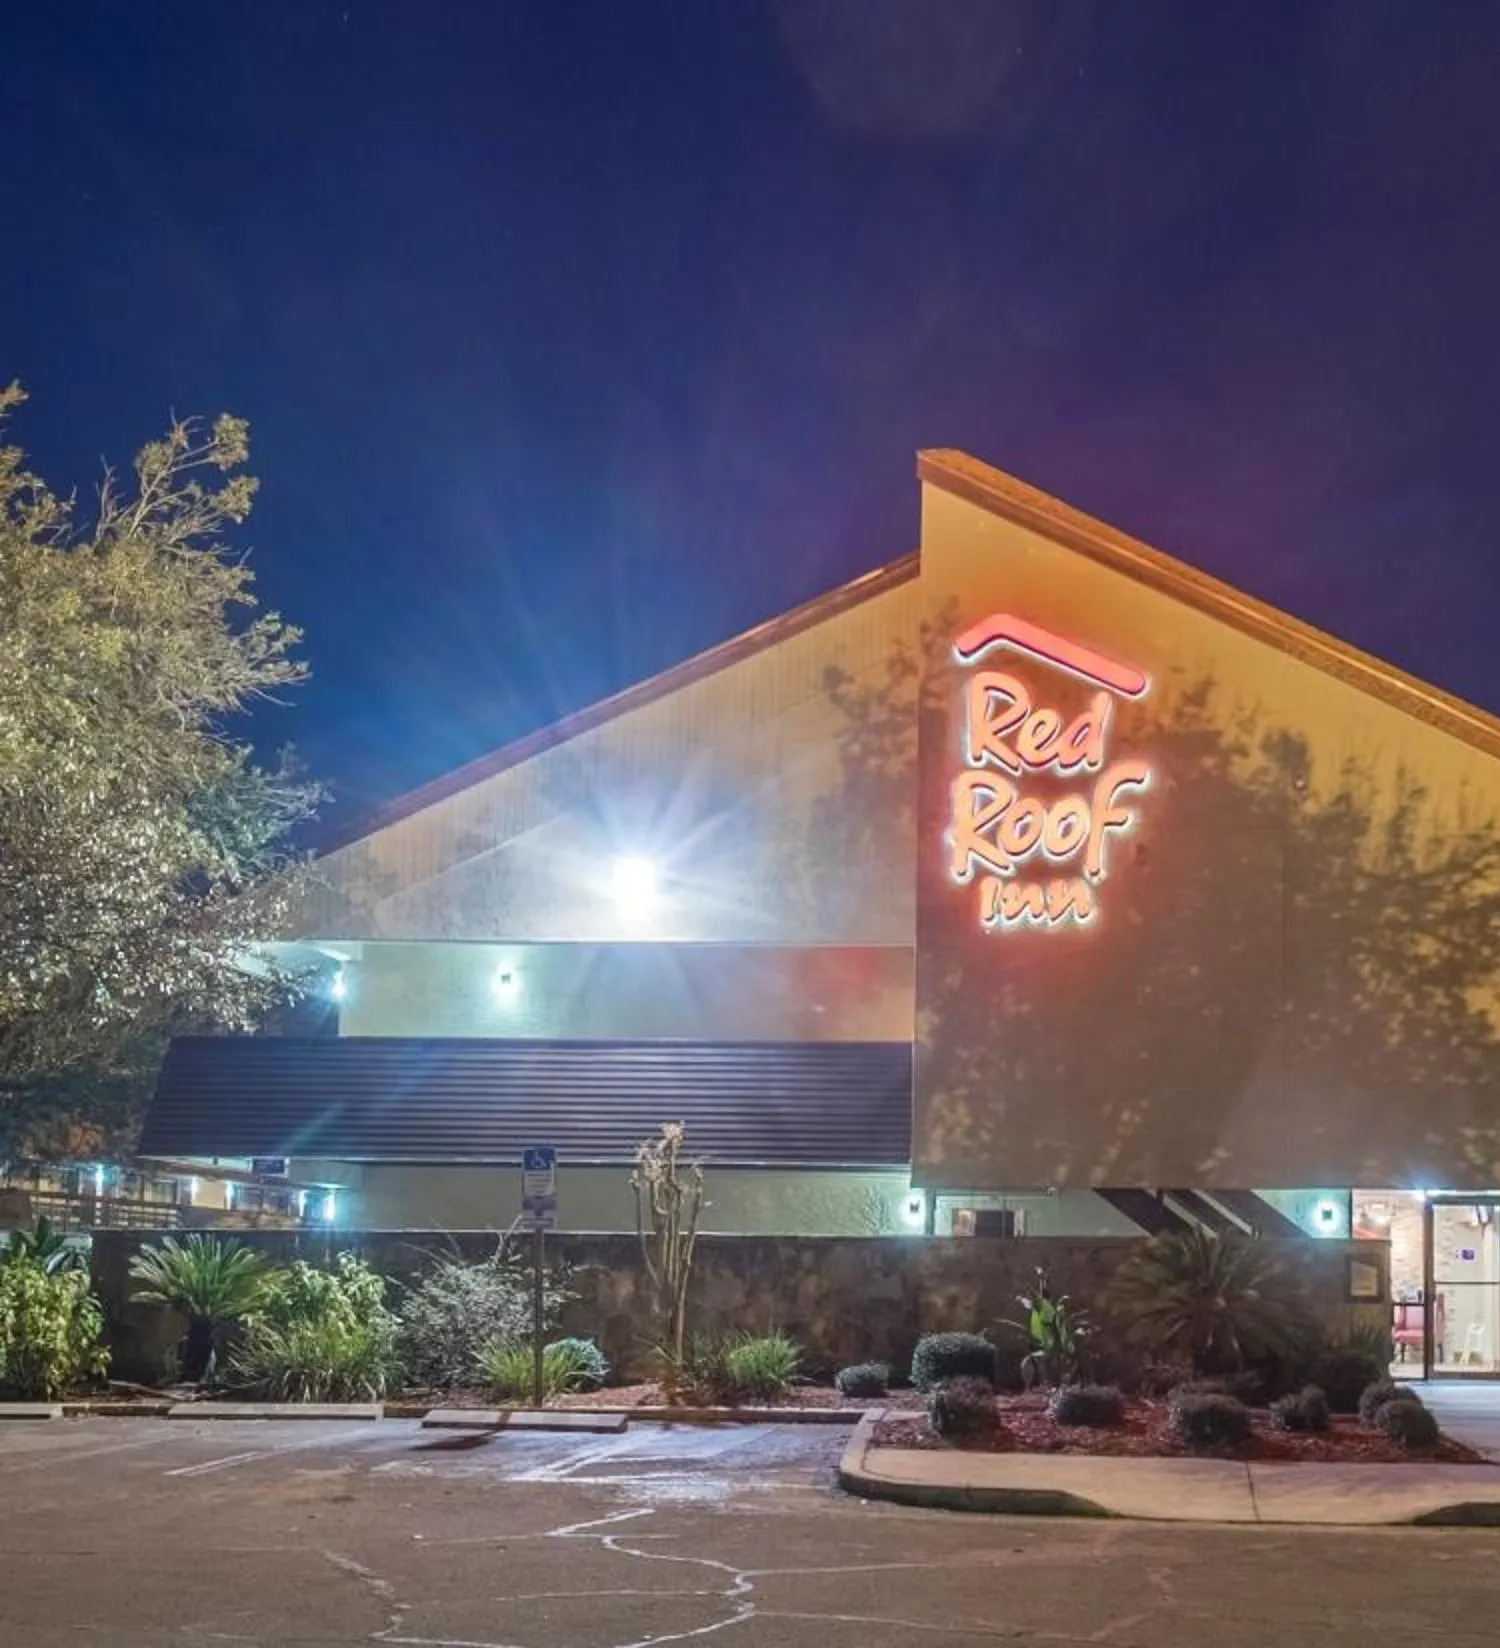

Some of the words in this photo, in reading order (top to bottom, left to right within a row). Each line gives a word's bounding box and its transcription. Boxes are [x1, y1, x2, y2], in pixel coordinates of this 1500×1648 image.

[967, 671, 1113, 774] Red
[949, 760, 1149, 880] Roof
[979, 876, 1096, 924] Inn
